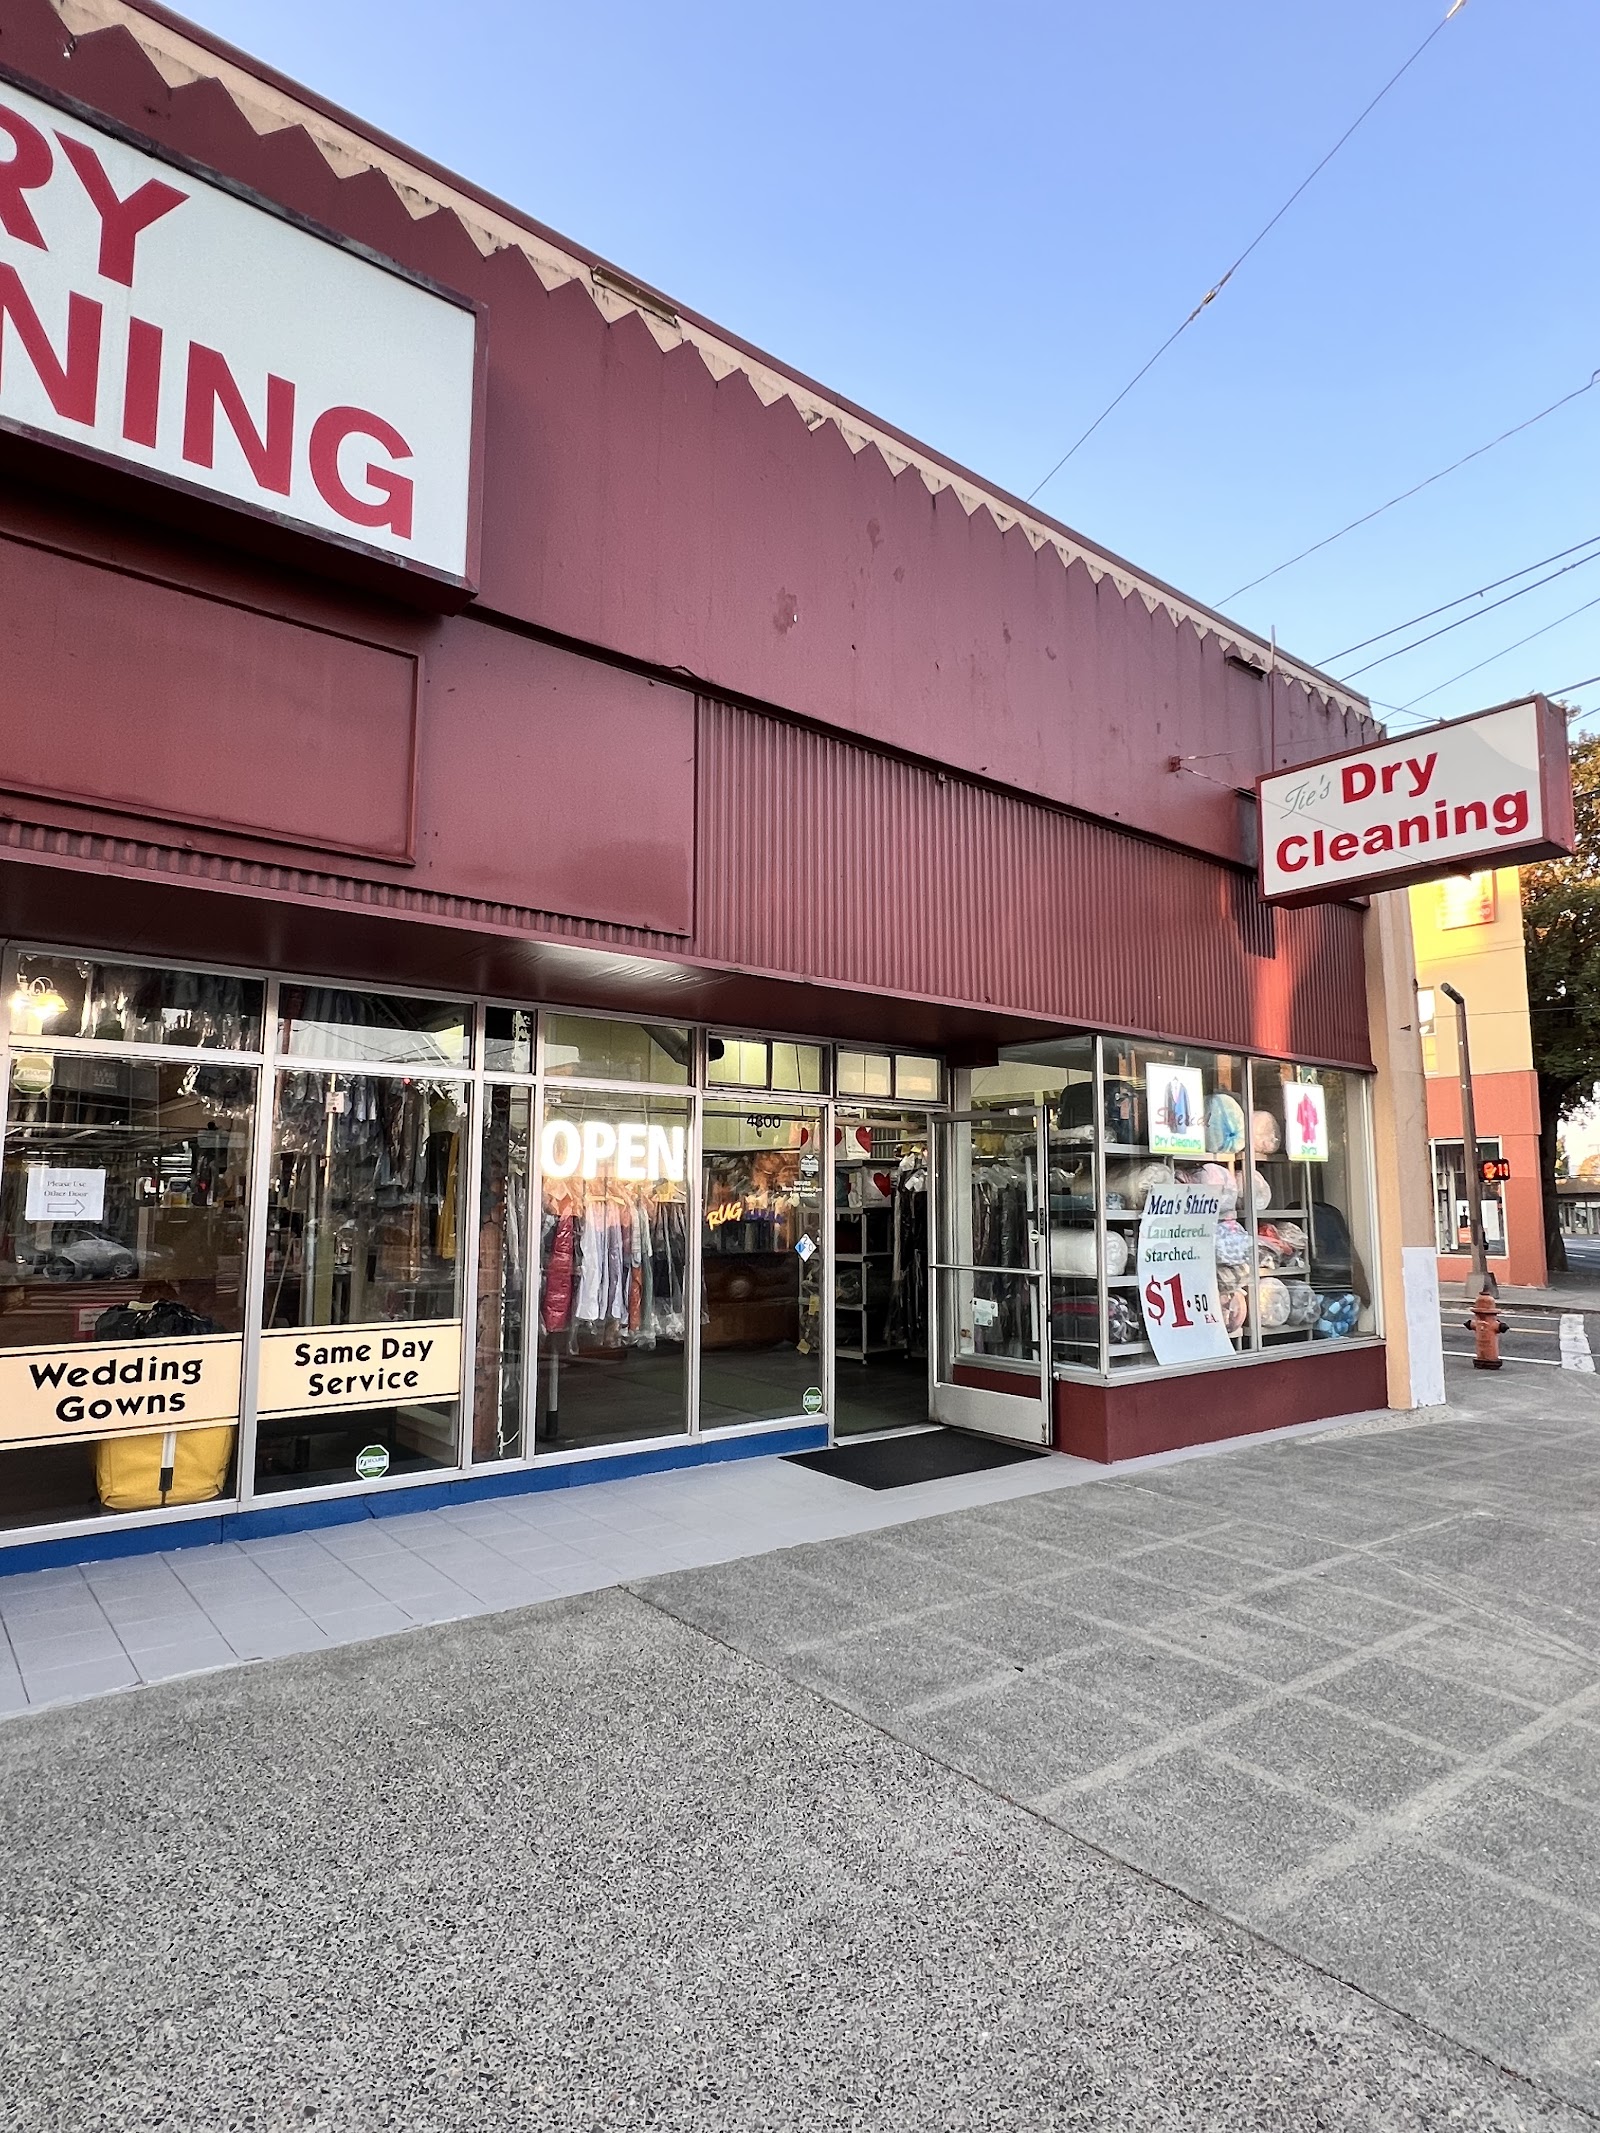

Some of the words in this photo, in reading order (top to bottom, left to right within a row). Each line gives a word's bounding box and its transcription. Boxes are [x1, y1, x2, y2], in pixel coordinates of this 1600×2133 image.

[0, 262, 414, 540] NING
[1281, 775, 1331, 819] Tie's
[1342, 752, 1438, 804] Dry
[1276, 790, 1528, 872] Cleaning
[540, 1119, 685, 1183] OPEN
[1154, 1135, 1168, 1147] Dry
[1170, 1136, 1202, 1149] Cleaning
[706, 1201, 743, 1231] RUG
[1147, 1194, 1182, 1215] Men's
[1184, 1193, 1219, 1215] Shirts
[295, 1343, 371, 1366] Same
[382, 1338, 434, 1361] Day
[29, 1356, 203, 1390] Wedding
[308, 1368, 419, 1396] Service
[56, 1393, 186, 1422] Gowns
